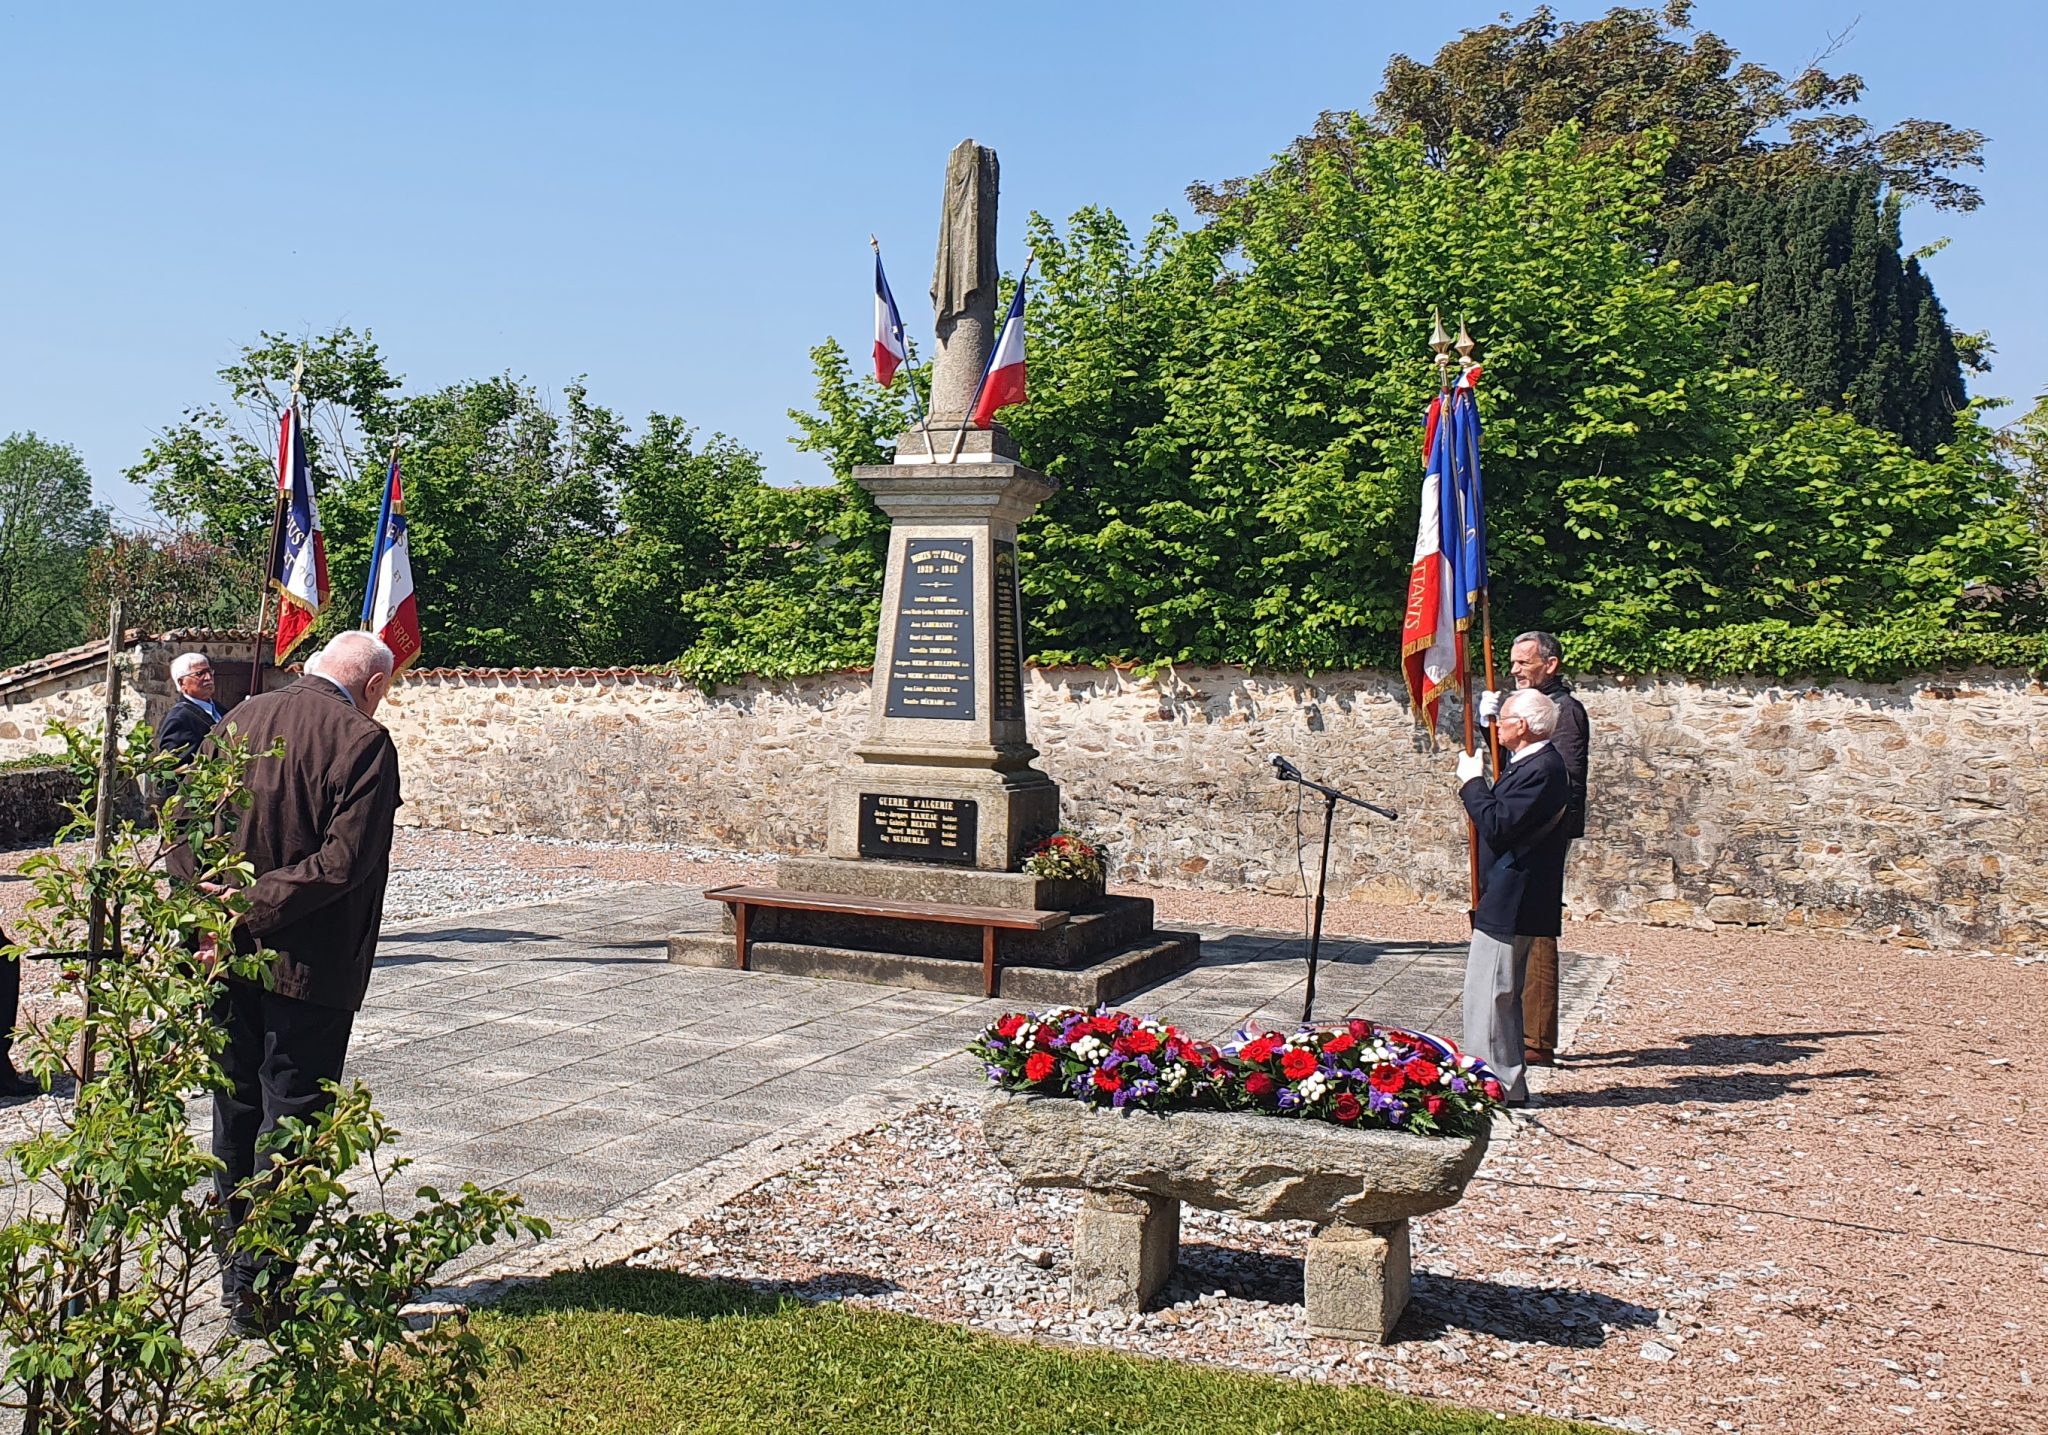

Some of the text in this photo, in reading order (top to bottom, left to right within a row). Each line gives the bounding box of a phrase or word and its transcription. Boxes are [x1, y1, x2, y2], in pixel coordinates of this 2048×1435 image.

[940, 550, 967, 564] FRANCE
[917, 565, 934, 574] 1939
[941, 565, 958, 574] 1945
[386, 605, 416, 655] GUERRE
[878, 796, 909, 807] GUERRE
